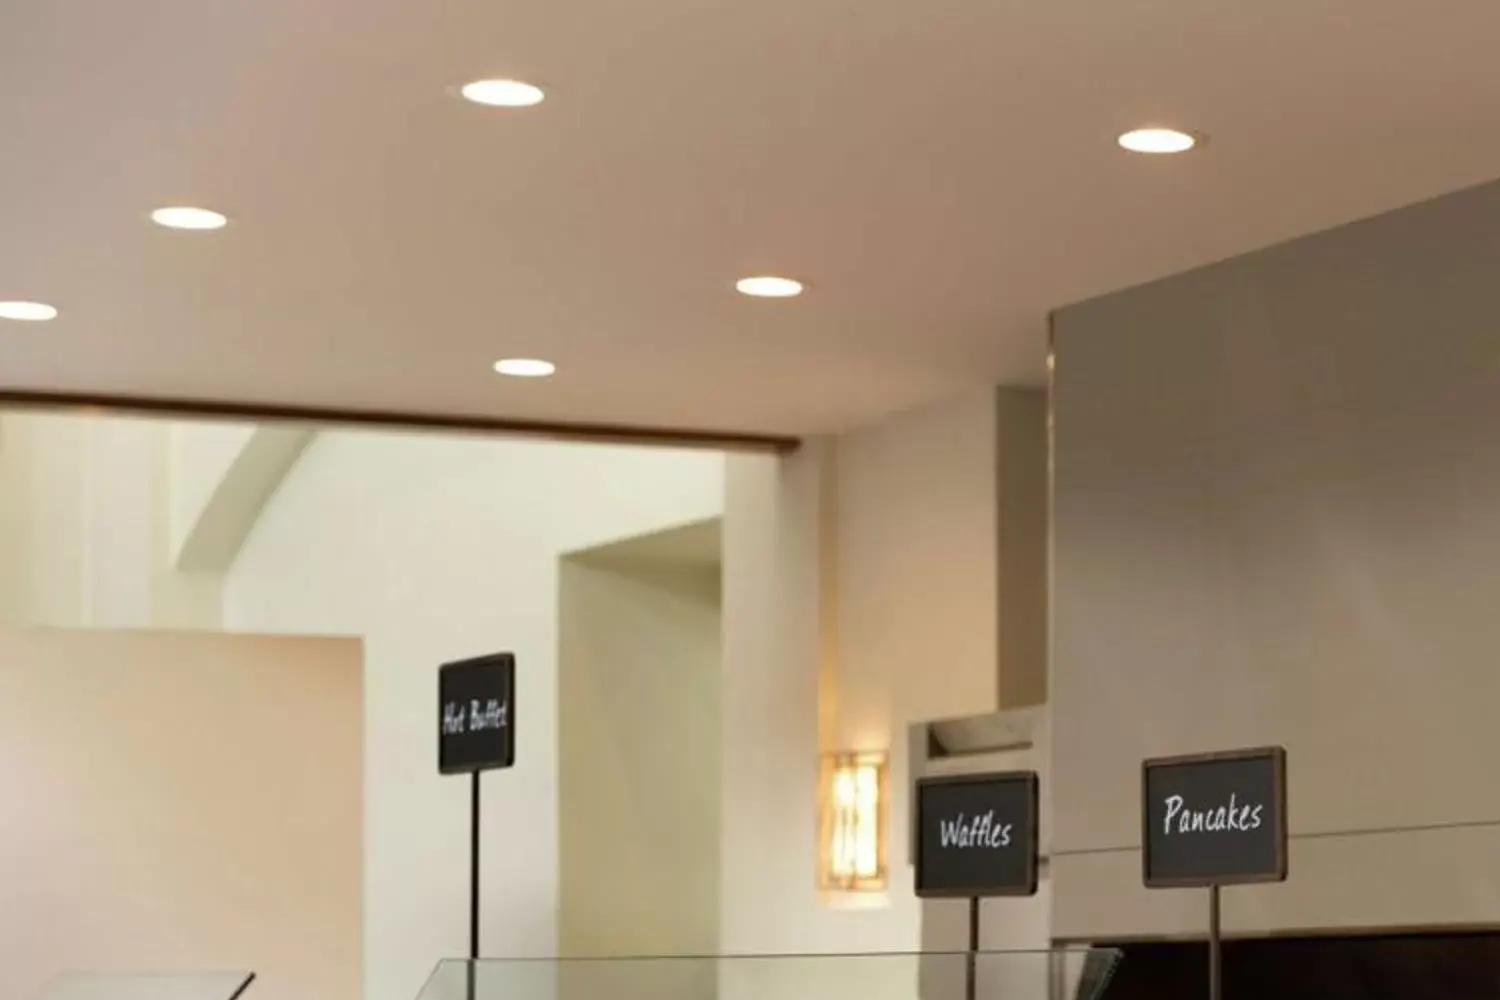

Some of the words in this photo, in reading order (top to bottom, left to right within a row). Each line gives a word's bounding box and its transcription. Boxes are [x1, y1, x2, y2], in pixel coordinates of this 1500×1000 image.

[442, 701, 464, 735] Hot
[469, 698, 507, 731] Buffet
[940, 810, 1012, 848] Waffles
[1164, 793, 1262, 835] Pancakes
